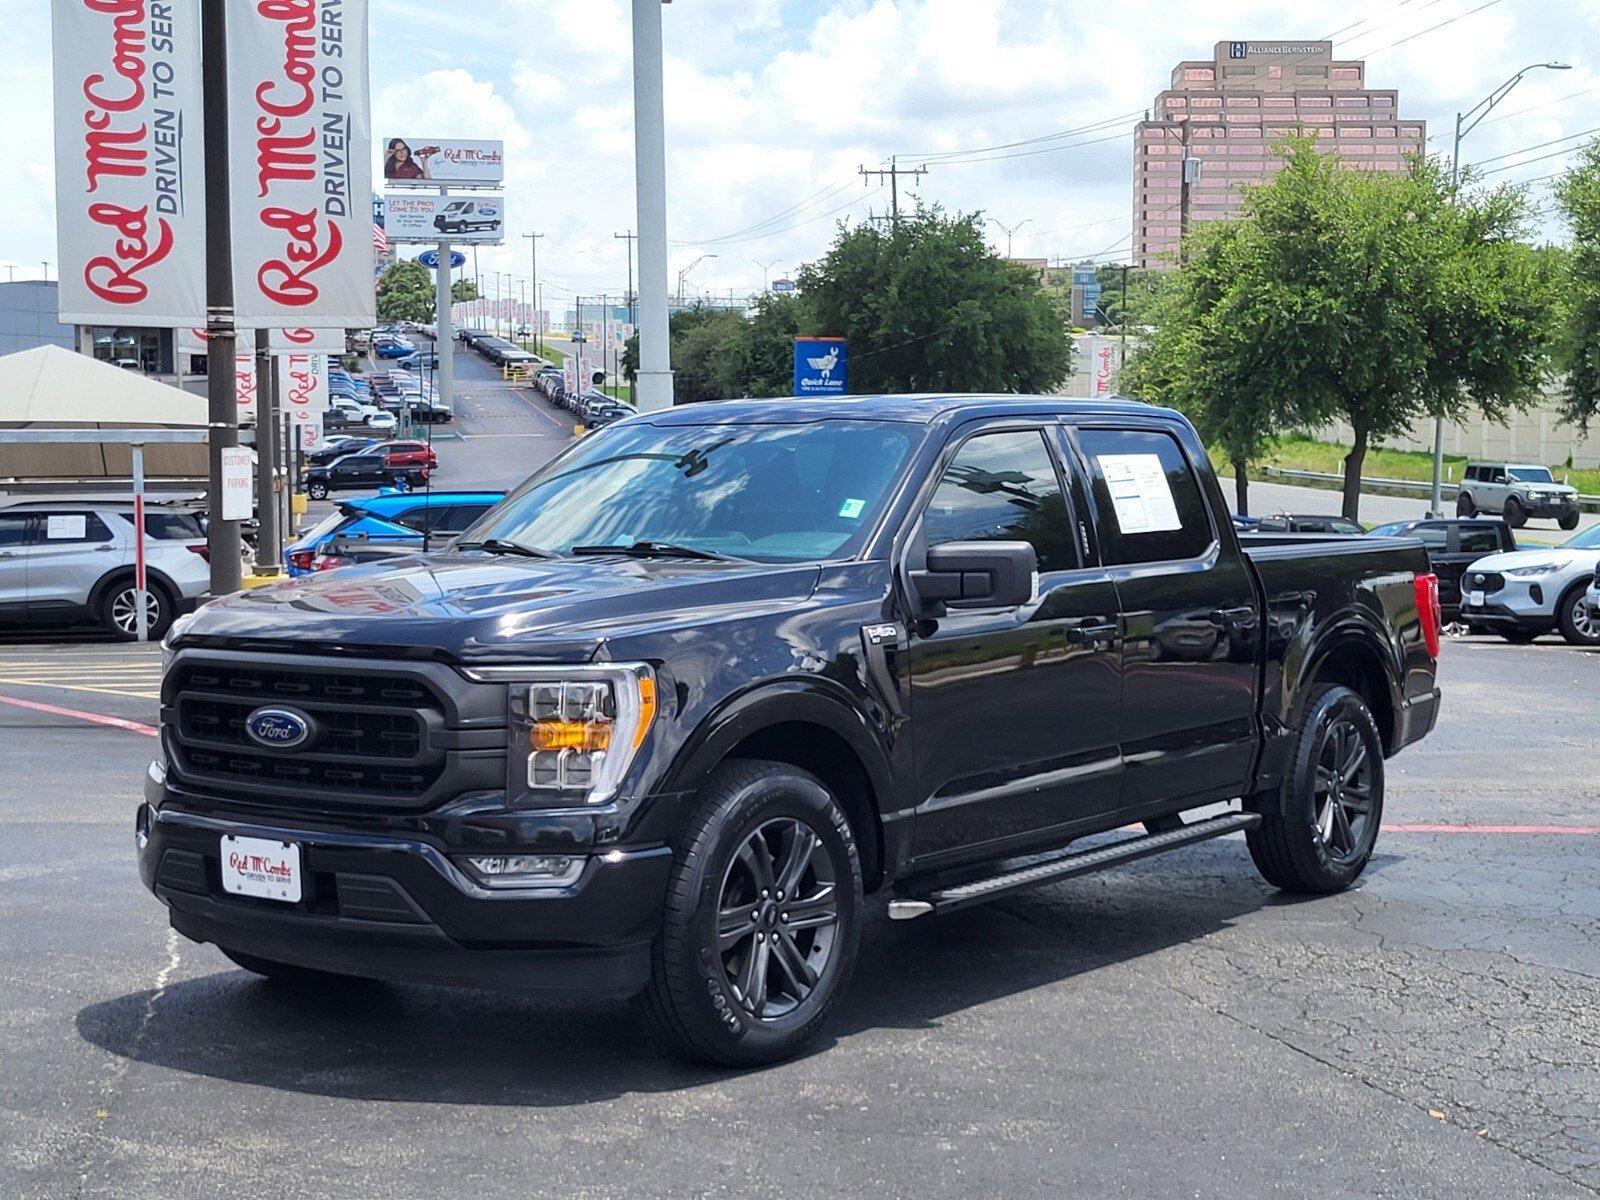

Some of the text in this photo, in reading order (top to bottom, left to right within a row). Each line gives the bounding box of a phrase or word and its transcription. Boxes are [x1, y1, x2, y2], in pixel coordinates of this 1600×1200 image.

[256, 0, 317, 198] McComb
[321, 66, 343, 103] TO
[150, 0, 178, 216] DRIVEN TO SER
[322, 112, 346, 217] DRIVEN
[444, 148, 461, 163] Red
[85, 203, 173, 304] Red
[257, 207, 342, 306] Red
[288, 371, 317, 405] Red
[801, 378, 823, 386] Quick
[259, 717, 293, 739] Ford
[229, 852, 248, 875] Red
